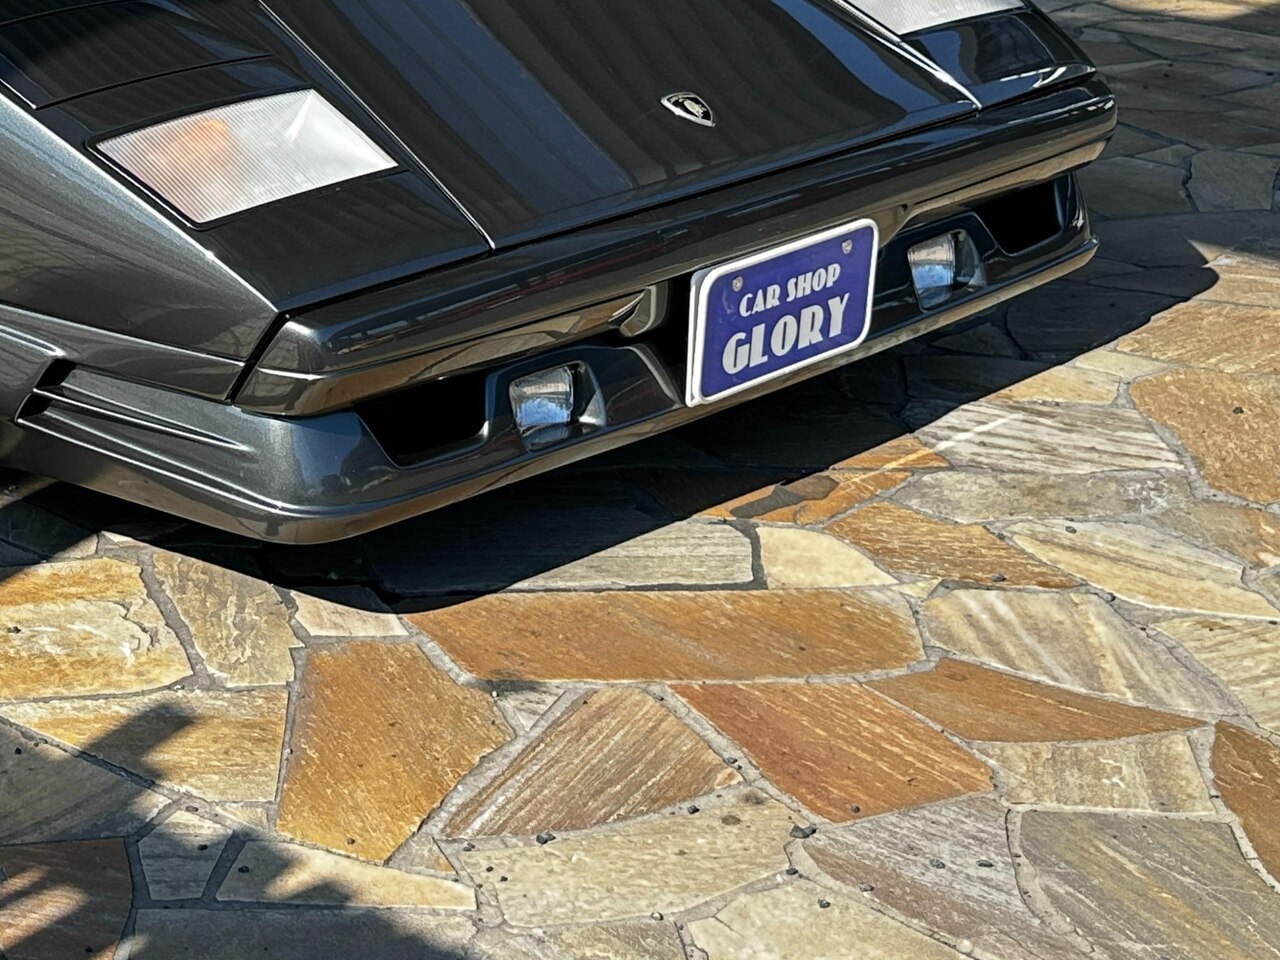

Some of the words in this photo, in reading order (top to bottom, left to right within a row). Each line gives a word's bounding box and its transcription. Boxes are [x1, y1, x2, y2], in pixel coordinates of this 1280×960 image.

[739, 284, 781, 317] CAR
[786, 263, 841, 302] SHOP
[722, 292, 851, 375] GLORY
